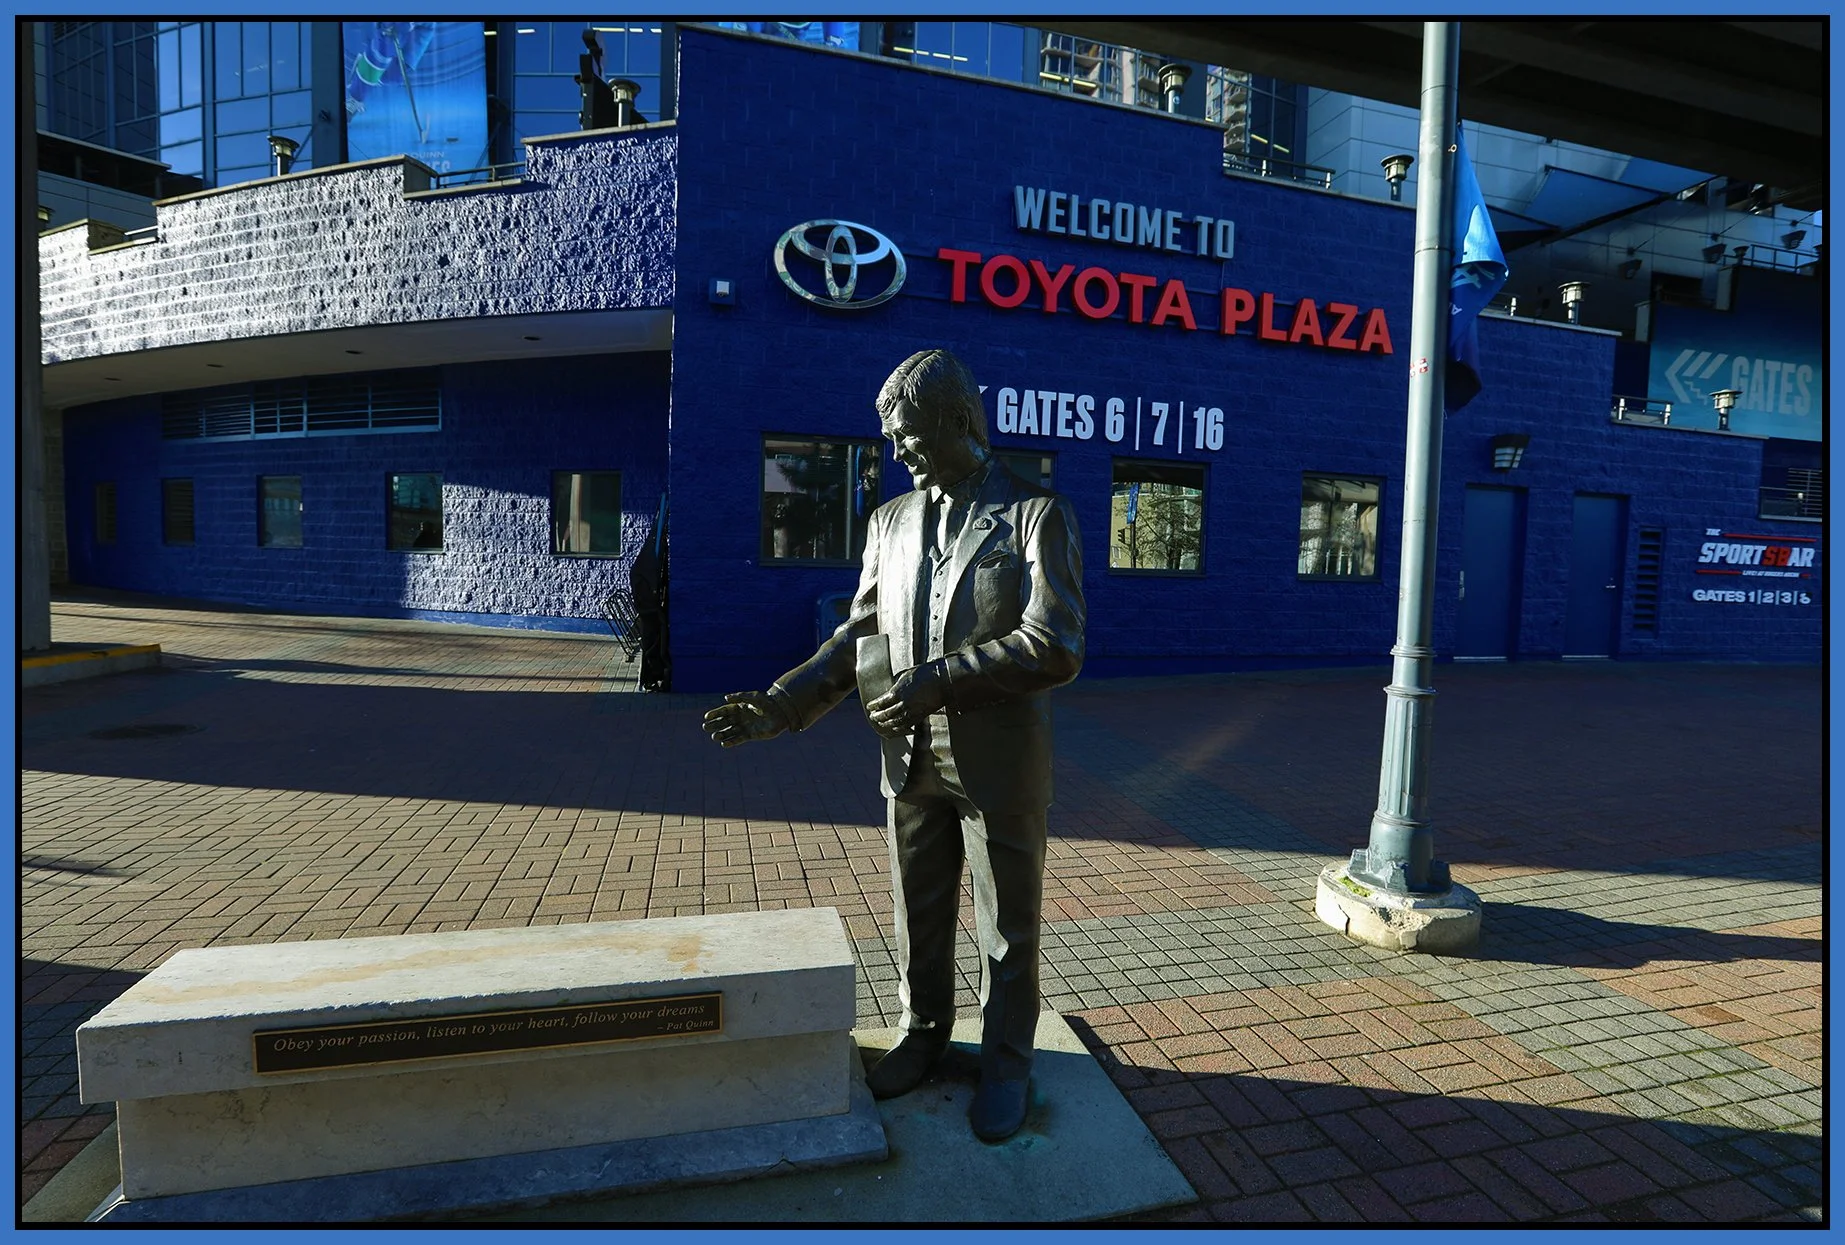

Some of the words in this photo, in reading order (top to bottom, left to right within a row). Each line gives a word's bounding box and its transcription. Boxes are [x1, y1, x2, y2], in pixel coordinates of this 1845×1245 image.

[1015, 185, 1182, 251] WELCOME
[1195, 215, 1235, 259] TO
[938, 248, 1197, 330] TOYOTA
[1220, 287, 1394, 355] PLAZA
[1731, 355, 1813, 416] GATES
[997, 387, 1095, 440] GATES
[1692, 589, 1746, 603] GATES
[273, 1037, 314, 1052] Obey
[317, 1035, 354, 1051] your
[358, 1029, 420, 1047] passion,
[426, 1025, 467, 1038] listen
[471, 1024, 485, 1035] to
[489, 1021, 524, 1035] your
[528, 1017, 569, 1030] heart,
[572, 1011, 618, 1029] follow
[620, 1009, 654, 1025] your
[657, 1005, 705, 1018] dreams
[666, 1022, 683, 1031] Pat
[685, 1020, 714, 1031] Quinn
